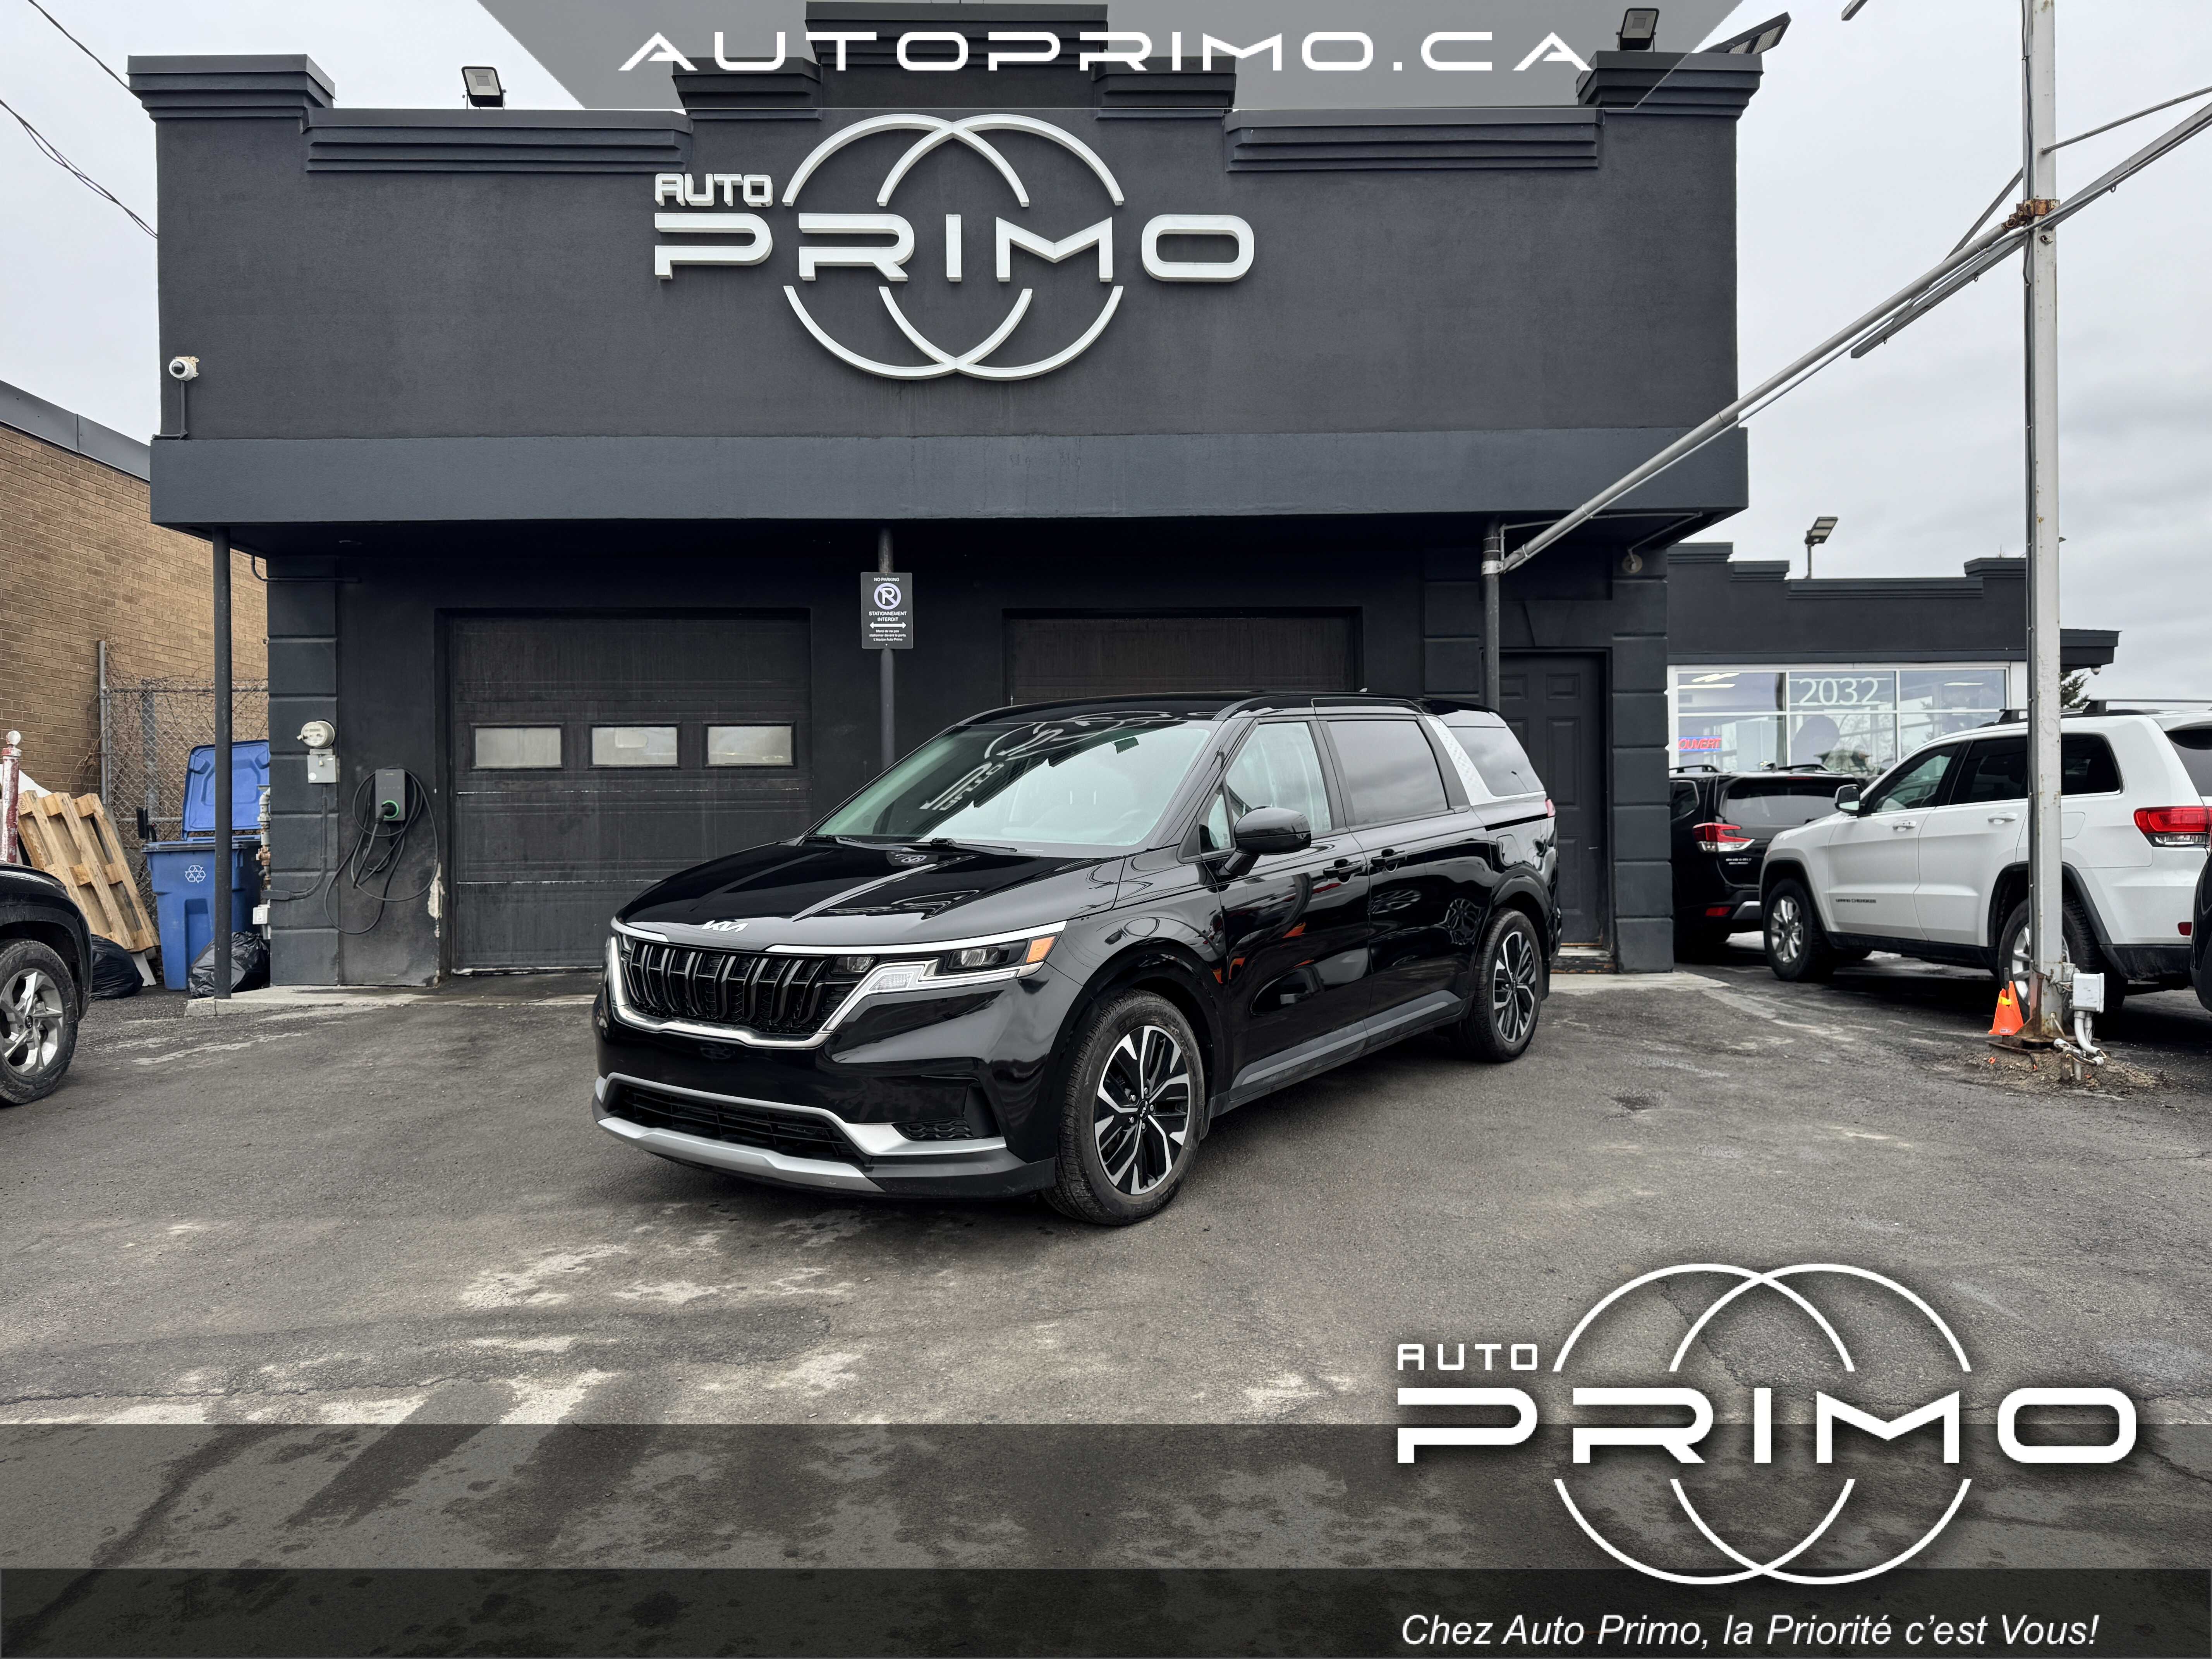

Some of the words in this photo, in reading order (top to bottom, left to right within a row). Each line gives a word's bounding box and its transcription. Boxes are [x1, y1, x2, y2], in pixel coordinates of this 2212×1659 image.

[654, 173, 773, 208] AUTO
[654, 213, 1255, 282] PRIMO
[1799, 677, 1881, 706] 2032
[1679, 738, 1722, 749] OUVERT
